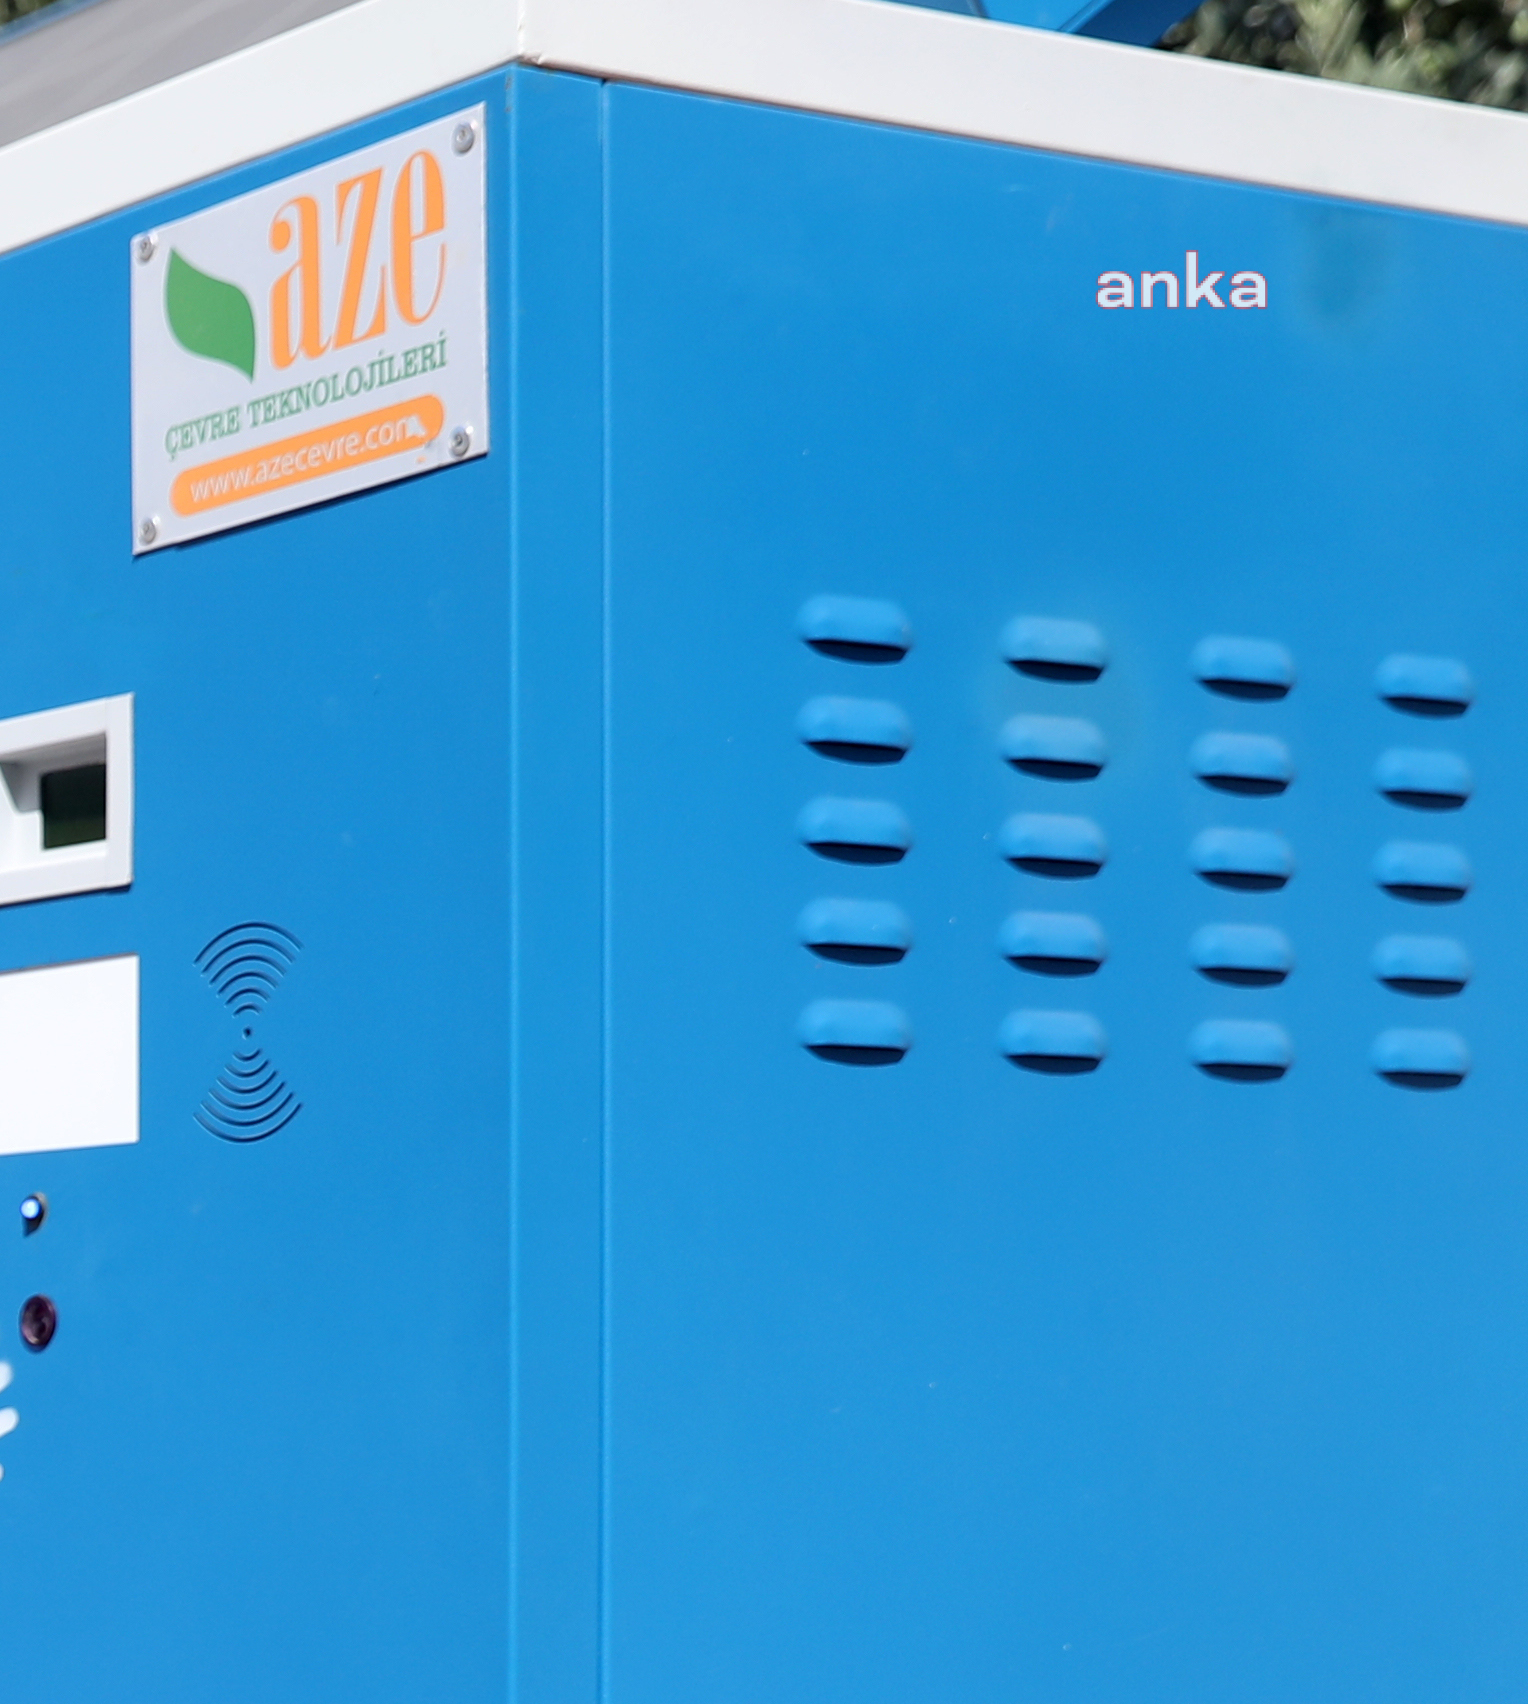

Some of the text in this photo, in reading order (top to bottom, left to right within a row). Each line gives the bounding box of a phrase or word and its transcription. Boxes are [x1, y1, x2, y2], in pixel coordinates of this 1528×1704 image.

[269, 148, 445, 371] aze
[165, 329, 448, 460] ÇEVRE TEKNOLOJİLERİ
